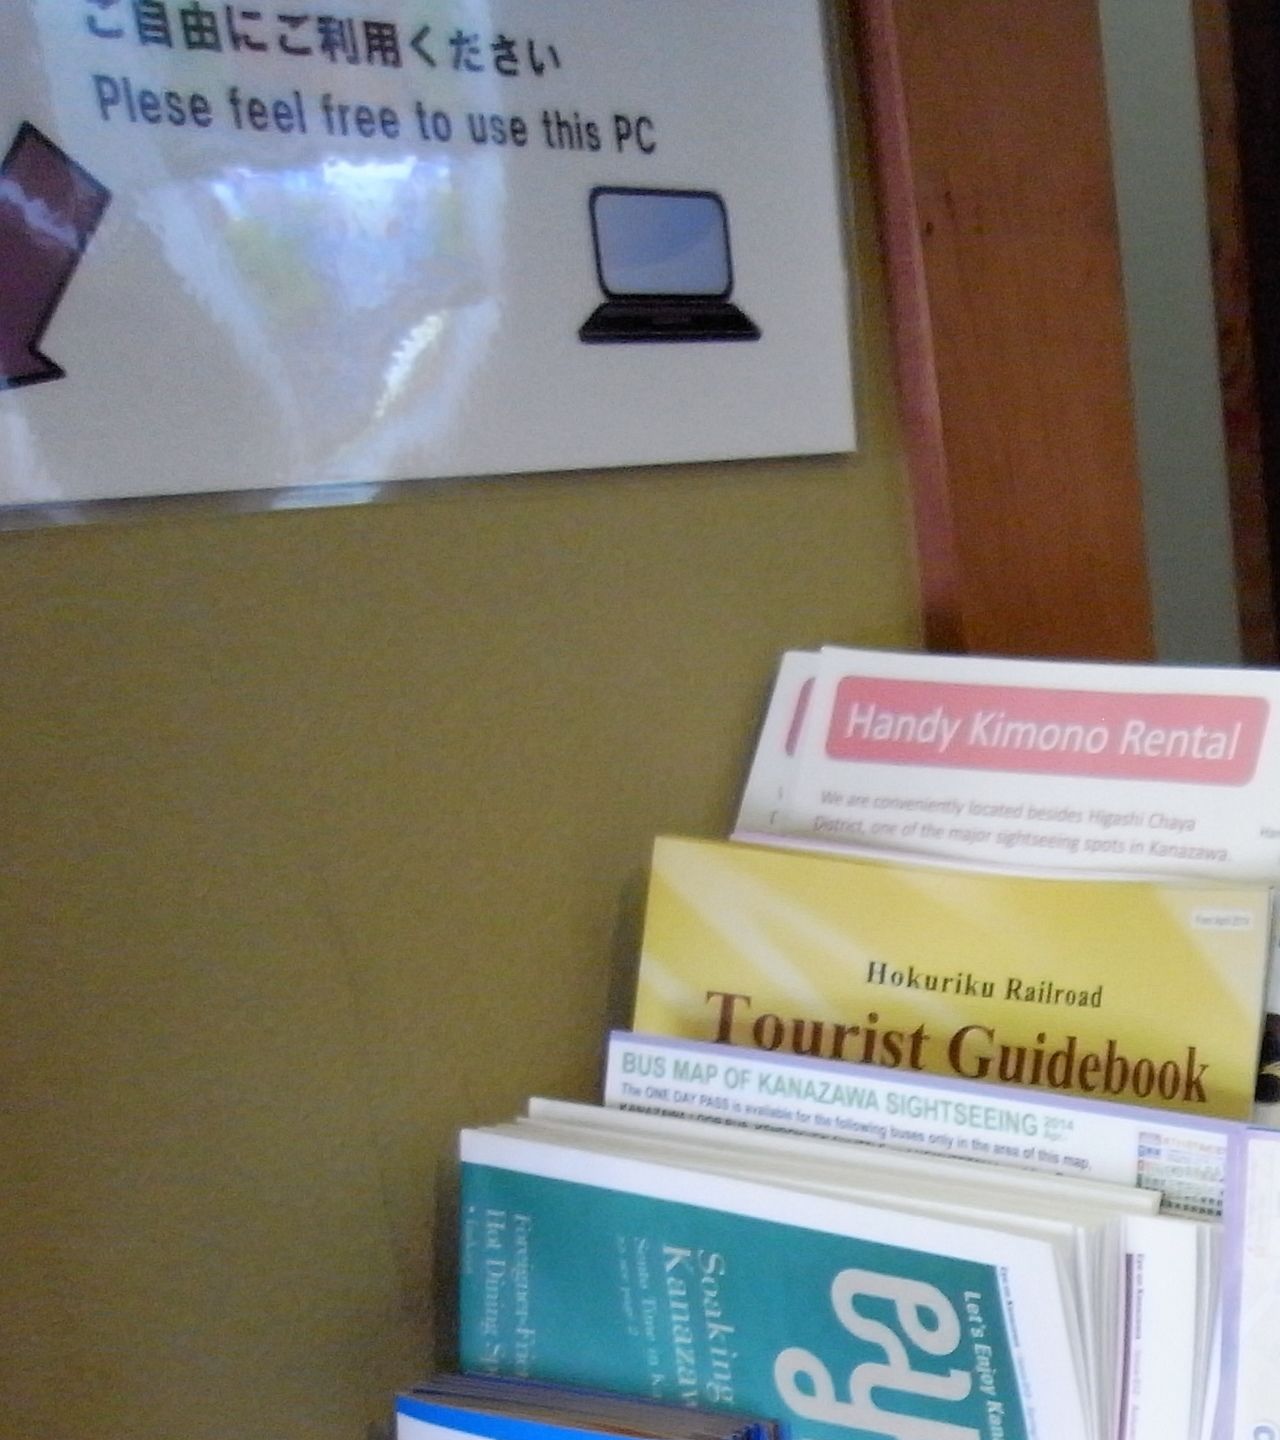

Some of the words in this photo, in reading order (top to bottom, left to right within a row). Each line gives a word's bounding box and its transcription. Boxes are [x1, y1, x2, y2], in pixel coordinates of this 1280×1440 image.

[92, 74, 213, 128] Plese
[229, 86, 307, 134] feel
[321, 93, 399, 139] free
[416, 101, 452, 142] to
[468, 111, 528, 148] use
[542, 110, 602, 152] this
[613, 113, 657, 154] PC
[845, 702, 962, 752] Handy
[968, 711, 1108, 756] Kimono
[1120, 719, 1242, 761] Rental
[866, 960, 995, 998] Hokuriku
[1004, 977, 1103, 1008] Railroad
[704, 990, 930, 1072] Tourist
[949, 1024, 1210, 1103] Guidebook
[622, 1051, 667, 1078] BUS
[673, 1058, 718, 1084] MAP
[723, 1066, 753, 1090] OF
[758, 1072, 880, 1112] KANAZAWA
[885, 1092, 1039, 1137] SIGHTSEEING
[974, 1344, 997, 1397] Enjoy
